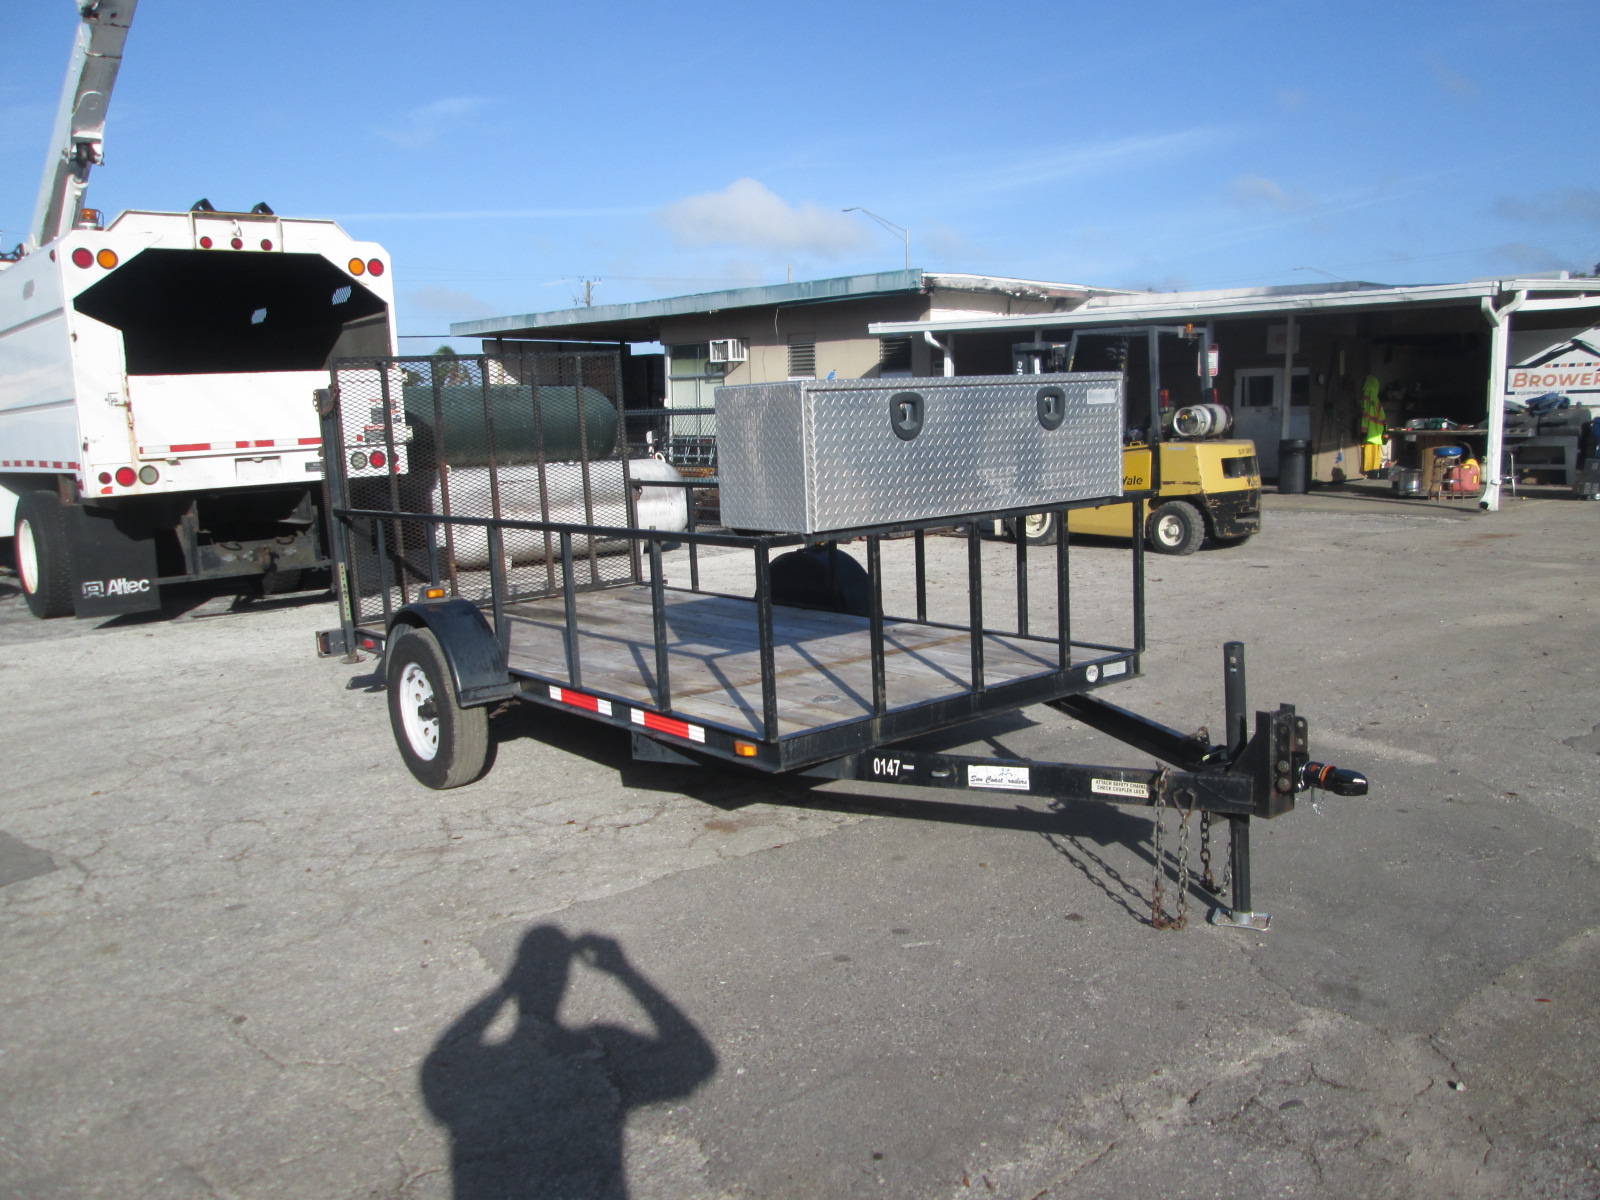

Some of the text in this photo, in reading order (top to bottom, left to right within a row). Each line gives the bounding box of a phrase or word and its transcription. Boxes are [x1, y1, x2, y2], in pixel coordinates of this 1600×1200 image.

[1122, 476, 1143, 486] Yale
[106, 578, 150, 596] Altec
[873, 757, 901, 776] 0147
